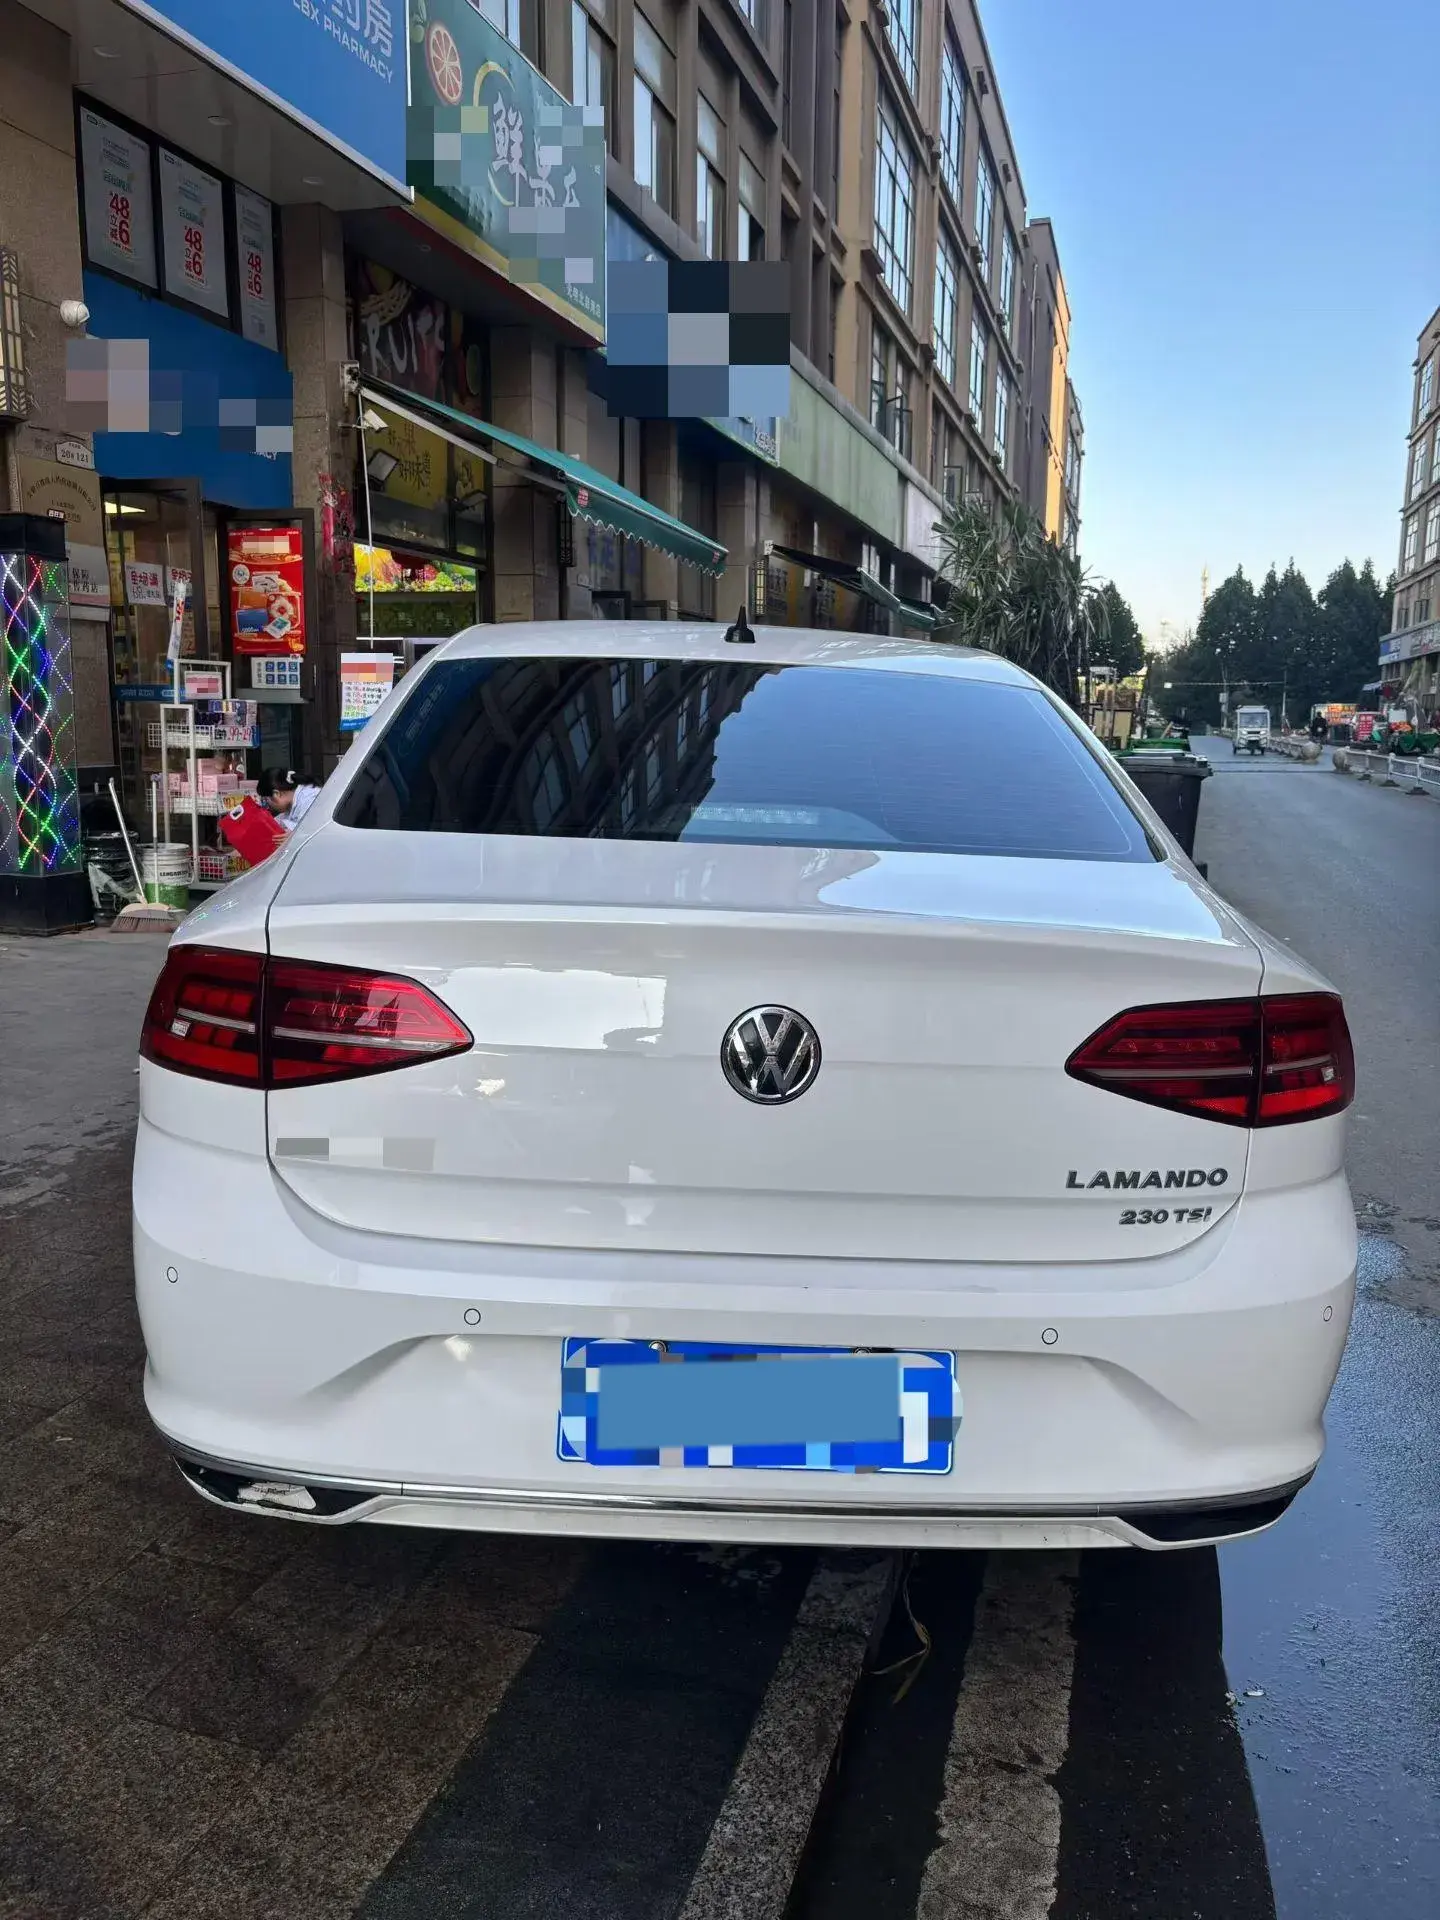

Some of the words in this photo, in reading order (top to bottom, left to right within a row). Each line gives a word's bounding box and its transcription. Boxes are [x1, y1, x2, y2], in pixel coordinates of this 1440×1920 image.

[324, 14, 393, 84] PHARMACY
[109, 193, 130, 219] 48
[118, 219, 130, 246] 6
[185, 227, 202, 252] 48
[192, 251, 202, 276] 6
[247, 252, 261, 274] 48
[254, 273, 262, 294] 6
[1066, 1168, 1229, 1189] LAMANDO
[1119, 1208, 1169, 1225] 230
[1174, 1206, 1213, 1223] TSI
